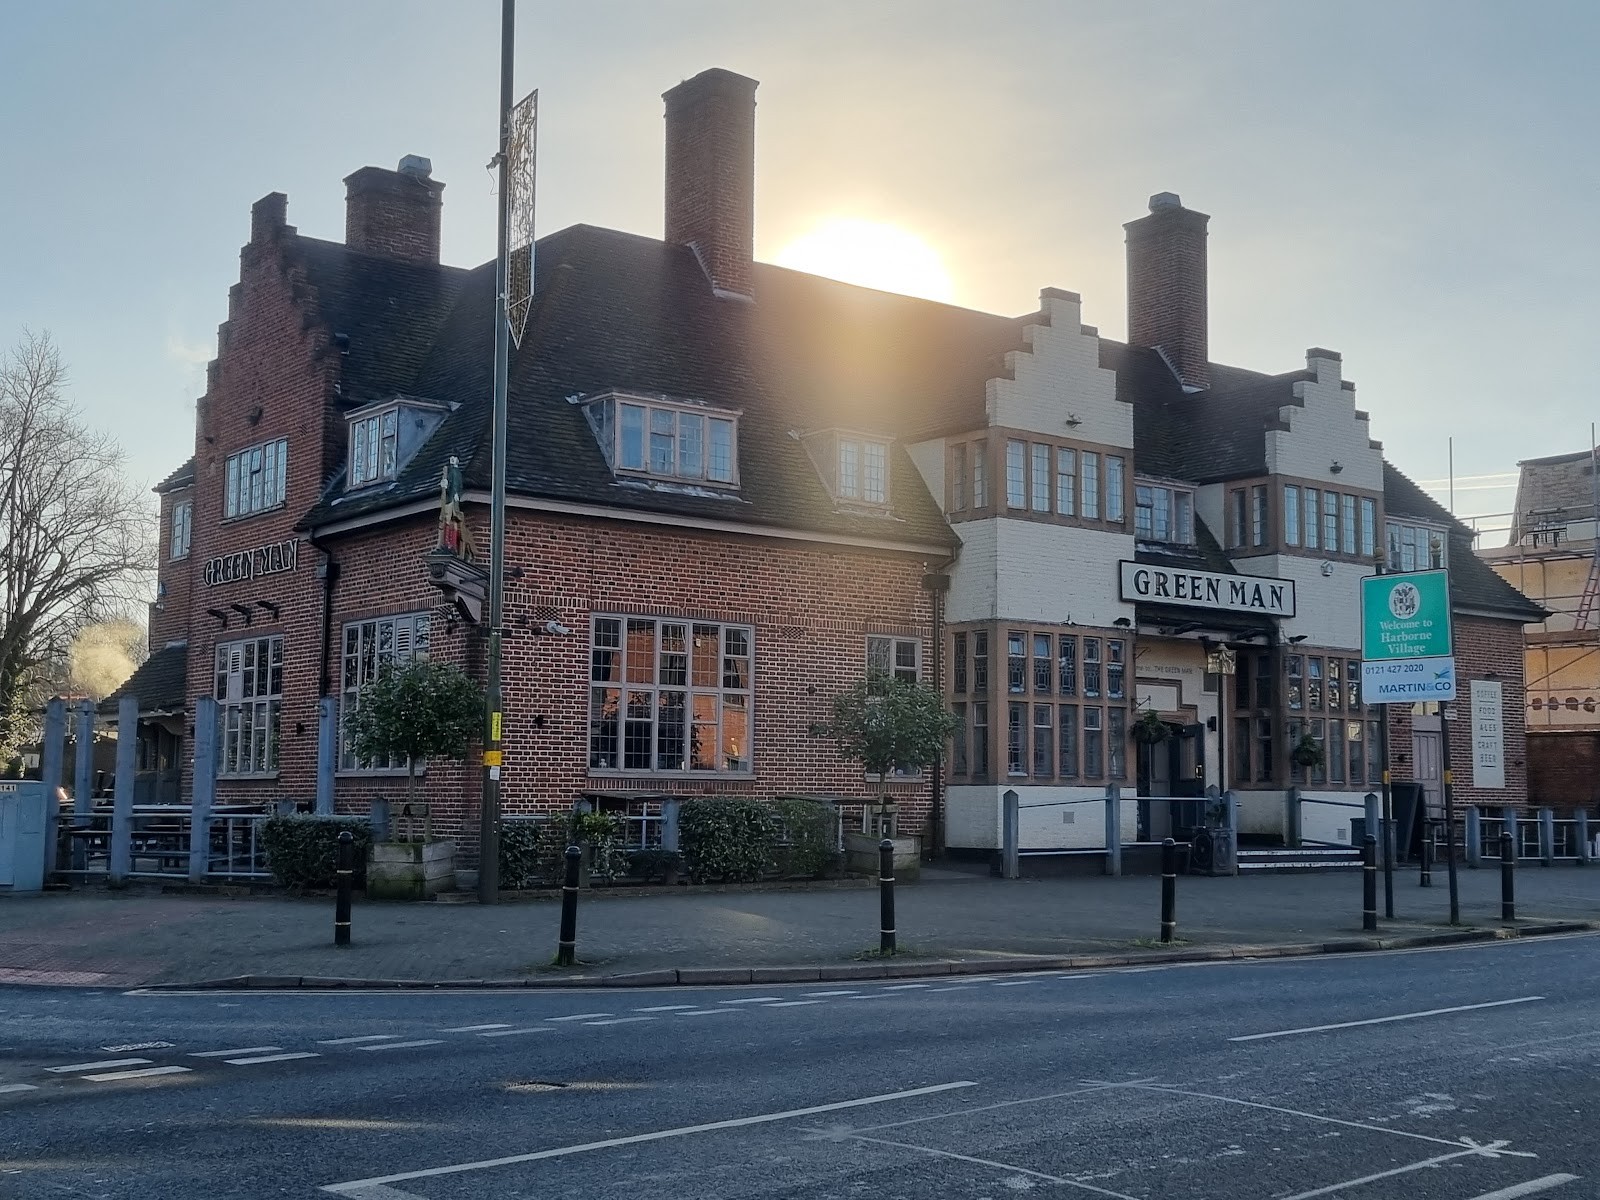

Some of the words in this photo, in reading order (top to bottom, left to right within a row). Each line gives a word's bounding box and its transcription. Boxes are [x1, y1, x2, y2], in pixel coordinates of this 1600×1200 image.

[204, 549, 254, 587] GREEN
[255, 538, 299, 575] MAN
[1133, 569, 1221, 604] GREEN
[1229, 580, 1285, 611] MAN
[1380, 621, 1420, 630] Welcome
[1381, 631, 1432, 643] Harborne
[1388, 643, 1426, 655] Village
[1365, 666, 1384, 674] 0121
[1387, 665, 1401, 673] 427
[1404, 664, 1424, 672] 2020
[1379, 681, 1452, 693] MARTIN&CO
[1477, 690, 1497, 699] COFFEE
[1479, 707, 1496, 715] FOOD
[1480, 724, 1497, 732] ALES
[1480, 754, 1496, 763] BEER
